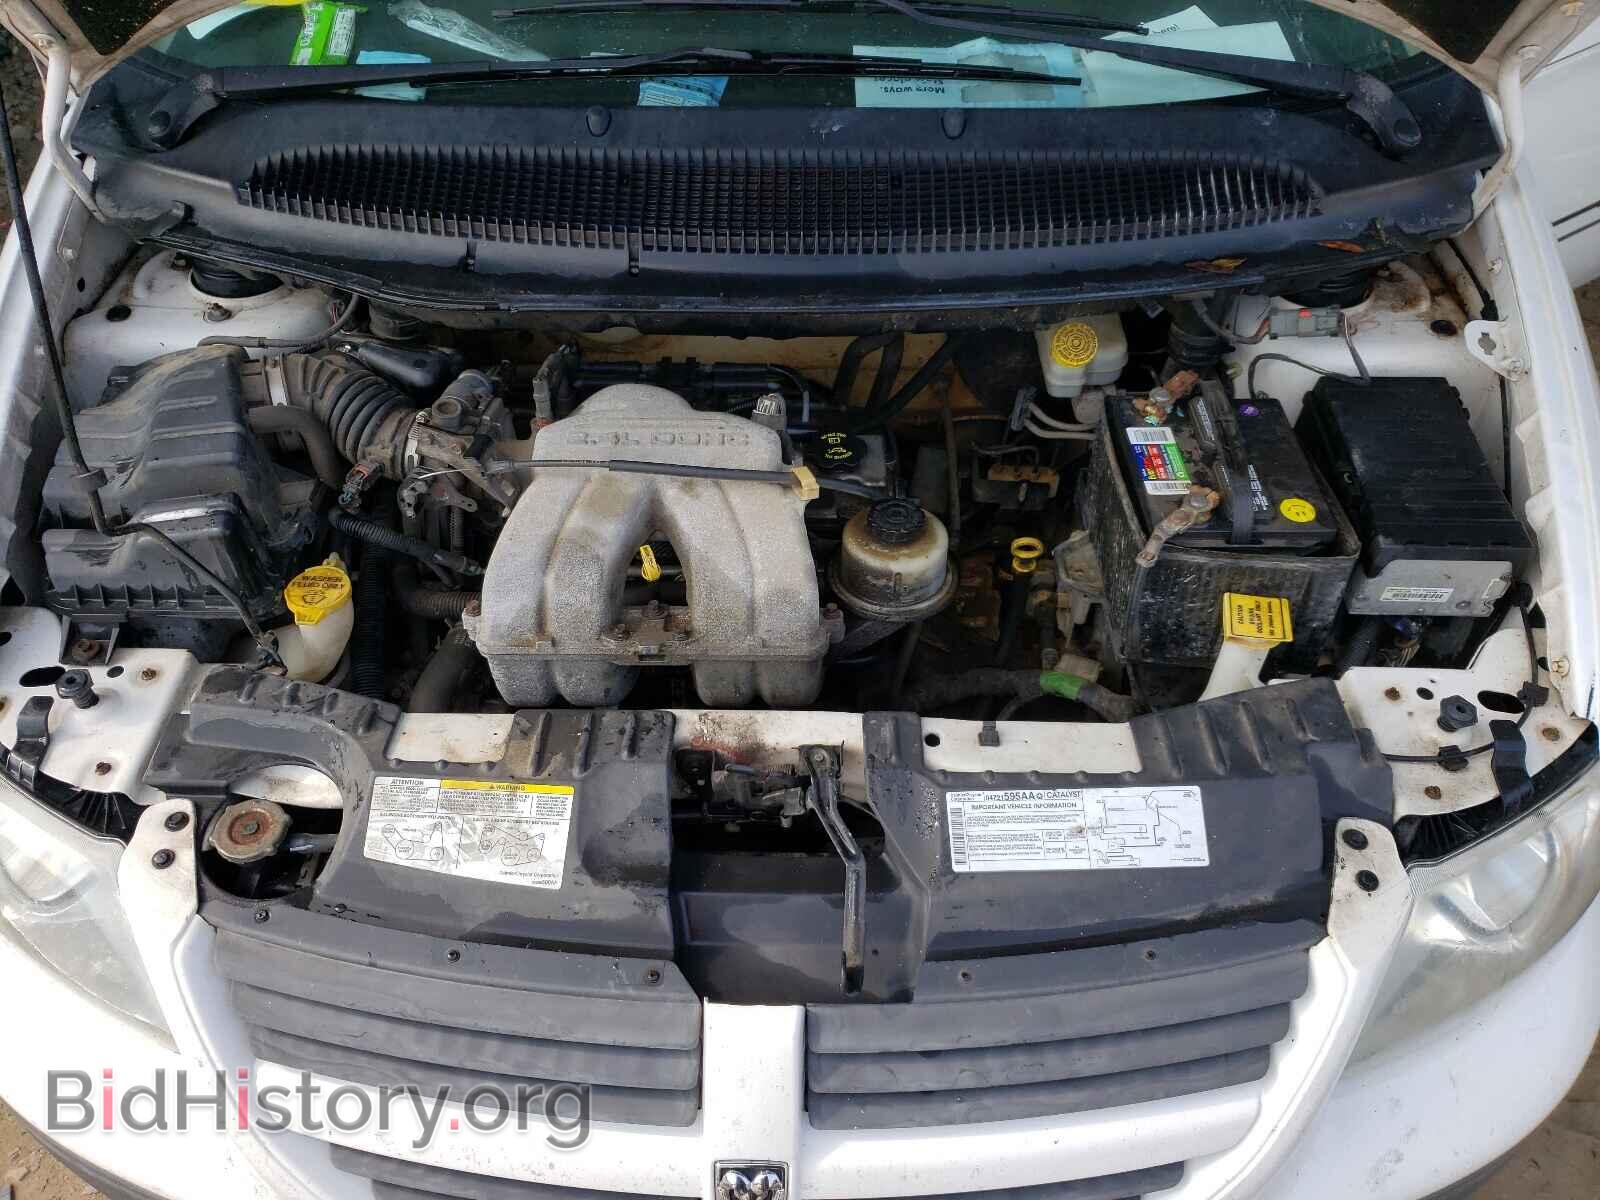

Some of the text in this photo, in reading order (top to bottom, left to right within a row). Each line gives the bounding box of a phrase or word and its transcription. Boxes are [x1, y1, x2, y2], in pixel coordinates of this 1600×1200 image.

[916, 86, 945, 94] More
[390, 778, 424, 786] ATTENTION
[495, 783, 526, 792] WARNING
[1046, 790, 1081, 799] CATALYST
[971, 801, 1078, 811] IMPORTANT VEHICLE INFORMATION
